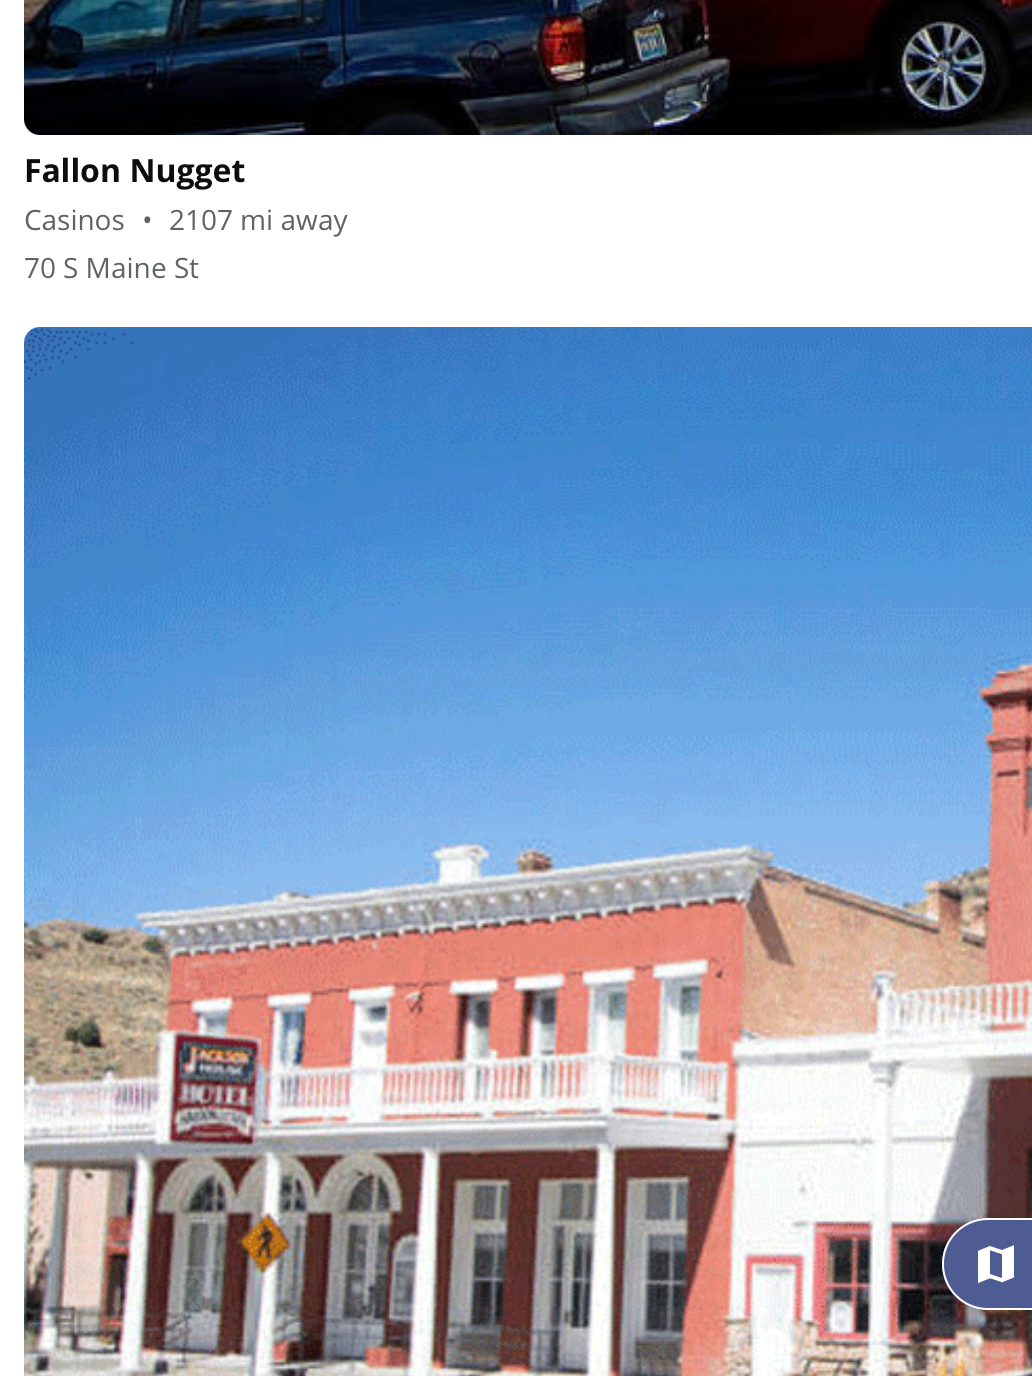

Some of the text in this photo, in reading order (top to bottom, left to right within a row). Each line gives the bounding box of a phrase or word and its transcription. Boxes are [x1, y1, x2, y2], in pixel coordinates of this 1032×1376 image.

[26, 156, 246, 191] Fallon Nugget
[25, 208, 349, 238] Casinos 2107 mi away
[24, 256, 199, 279] 70 S Maine St
